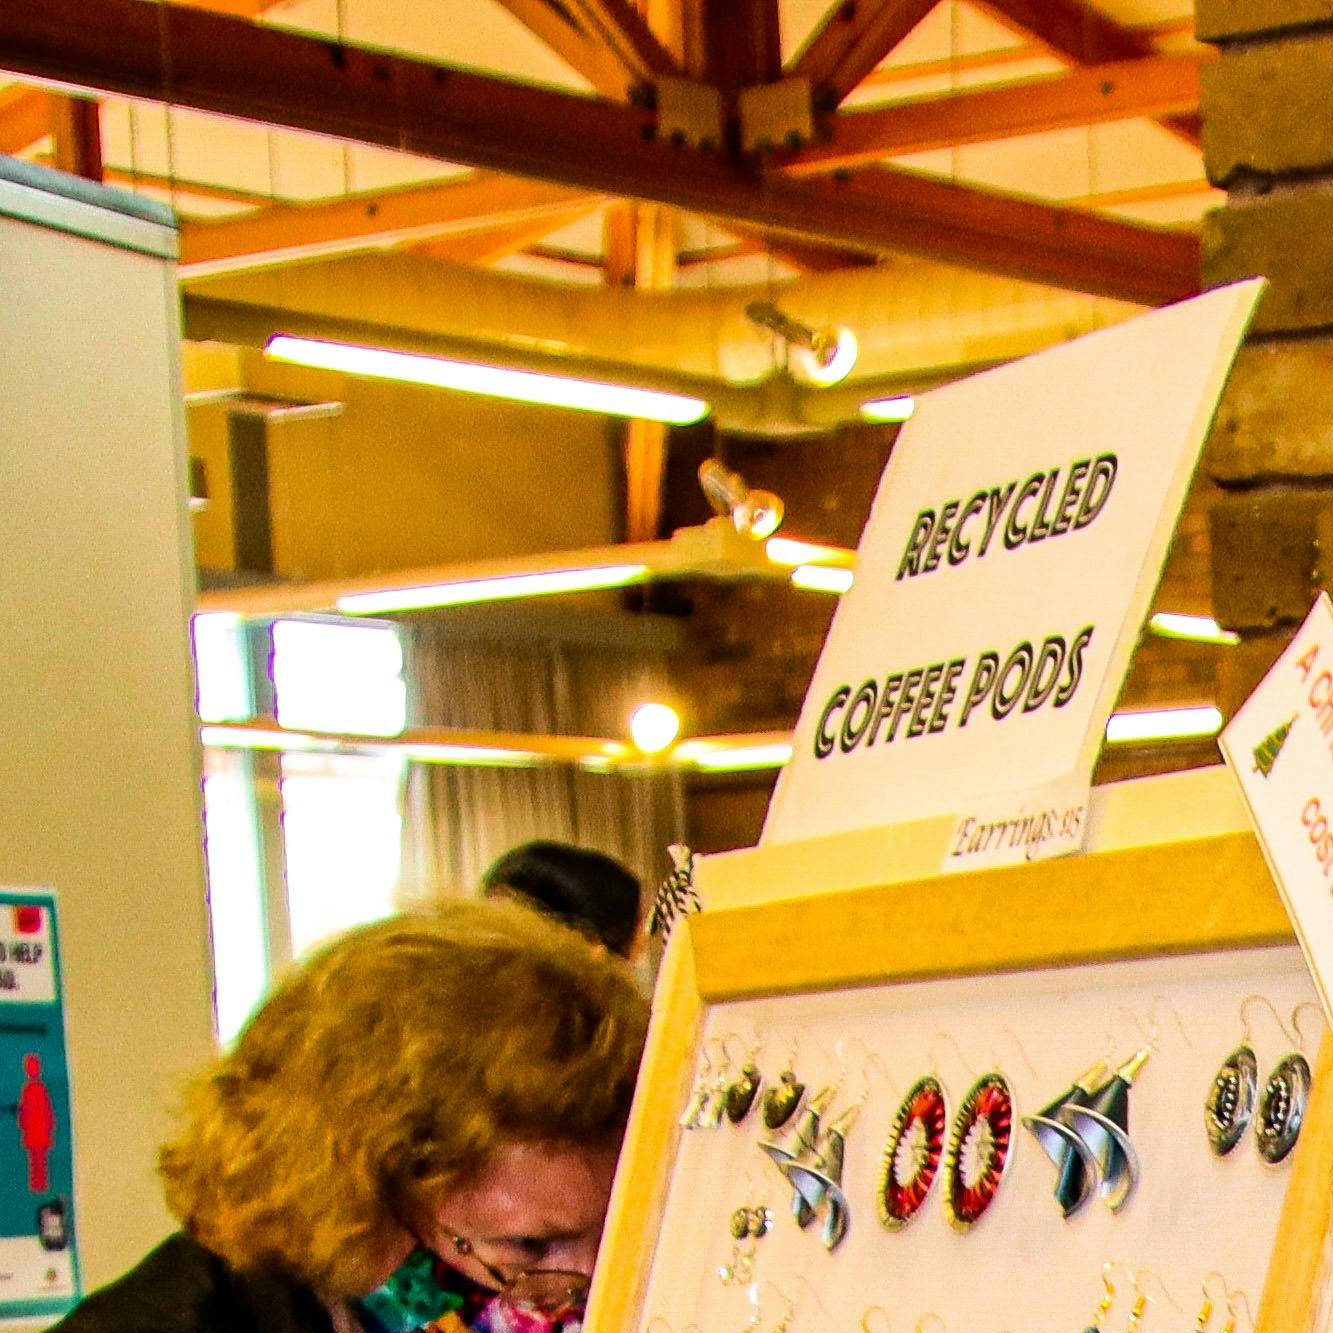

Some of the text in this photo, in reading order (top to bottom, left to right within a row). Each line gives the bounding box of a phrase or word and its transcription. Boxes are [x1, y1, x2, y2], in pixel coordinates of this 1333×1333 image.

[896, 454, 1117, 581] RECYCLED
[815, 627, 1093, 758] COFFEE PODS
[1296, 643, 1320, 684] A
[1301, 796, 1333, 877] cost
